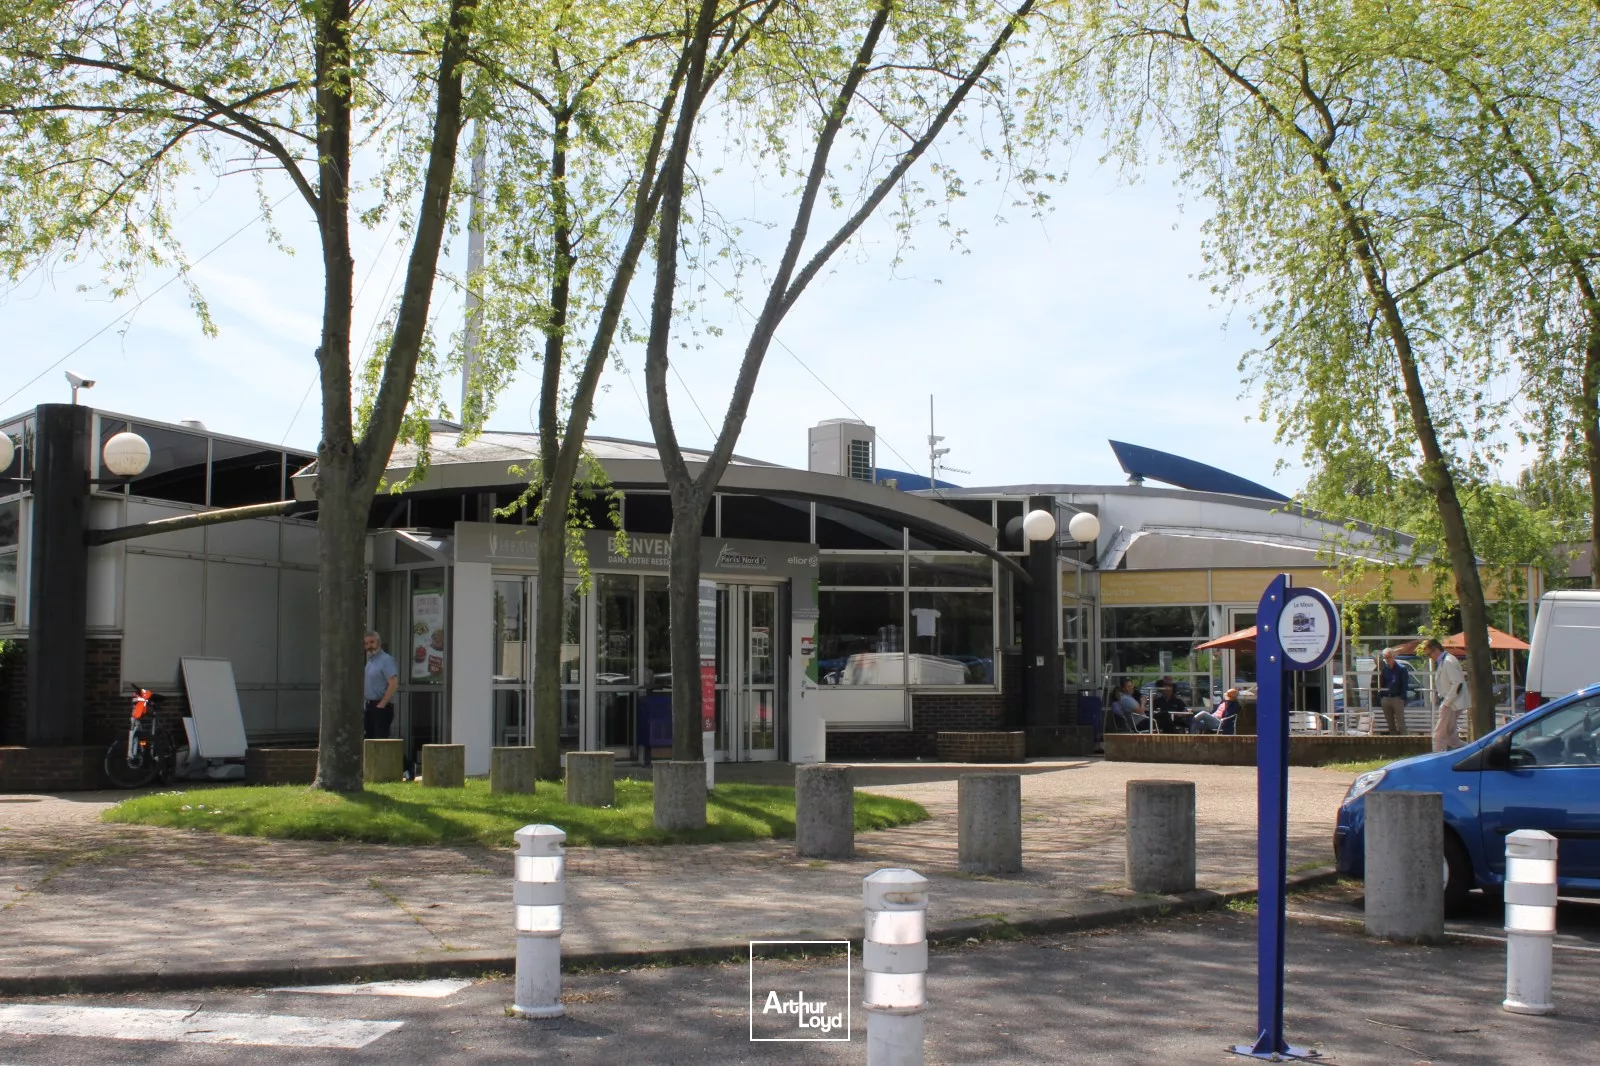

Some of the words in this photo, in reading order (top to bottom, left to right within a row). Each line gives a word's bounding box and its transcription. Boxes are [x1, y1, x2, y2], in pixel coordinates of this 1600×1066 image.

[608, 556, 626, 564] DANS
[628, 557, 650, 565] VOTRE
[721, 555, 740, 563] Paris
[742, 556, 759, 564] Nord
[762, 557, 767, 565] 2
